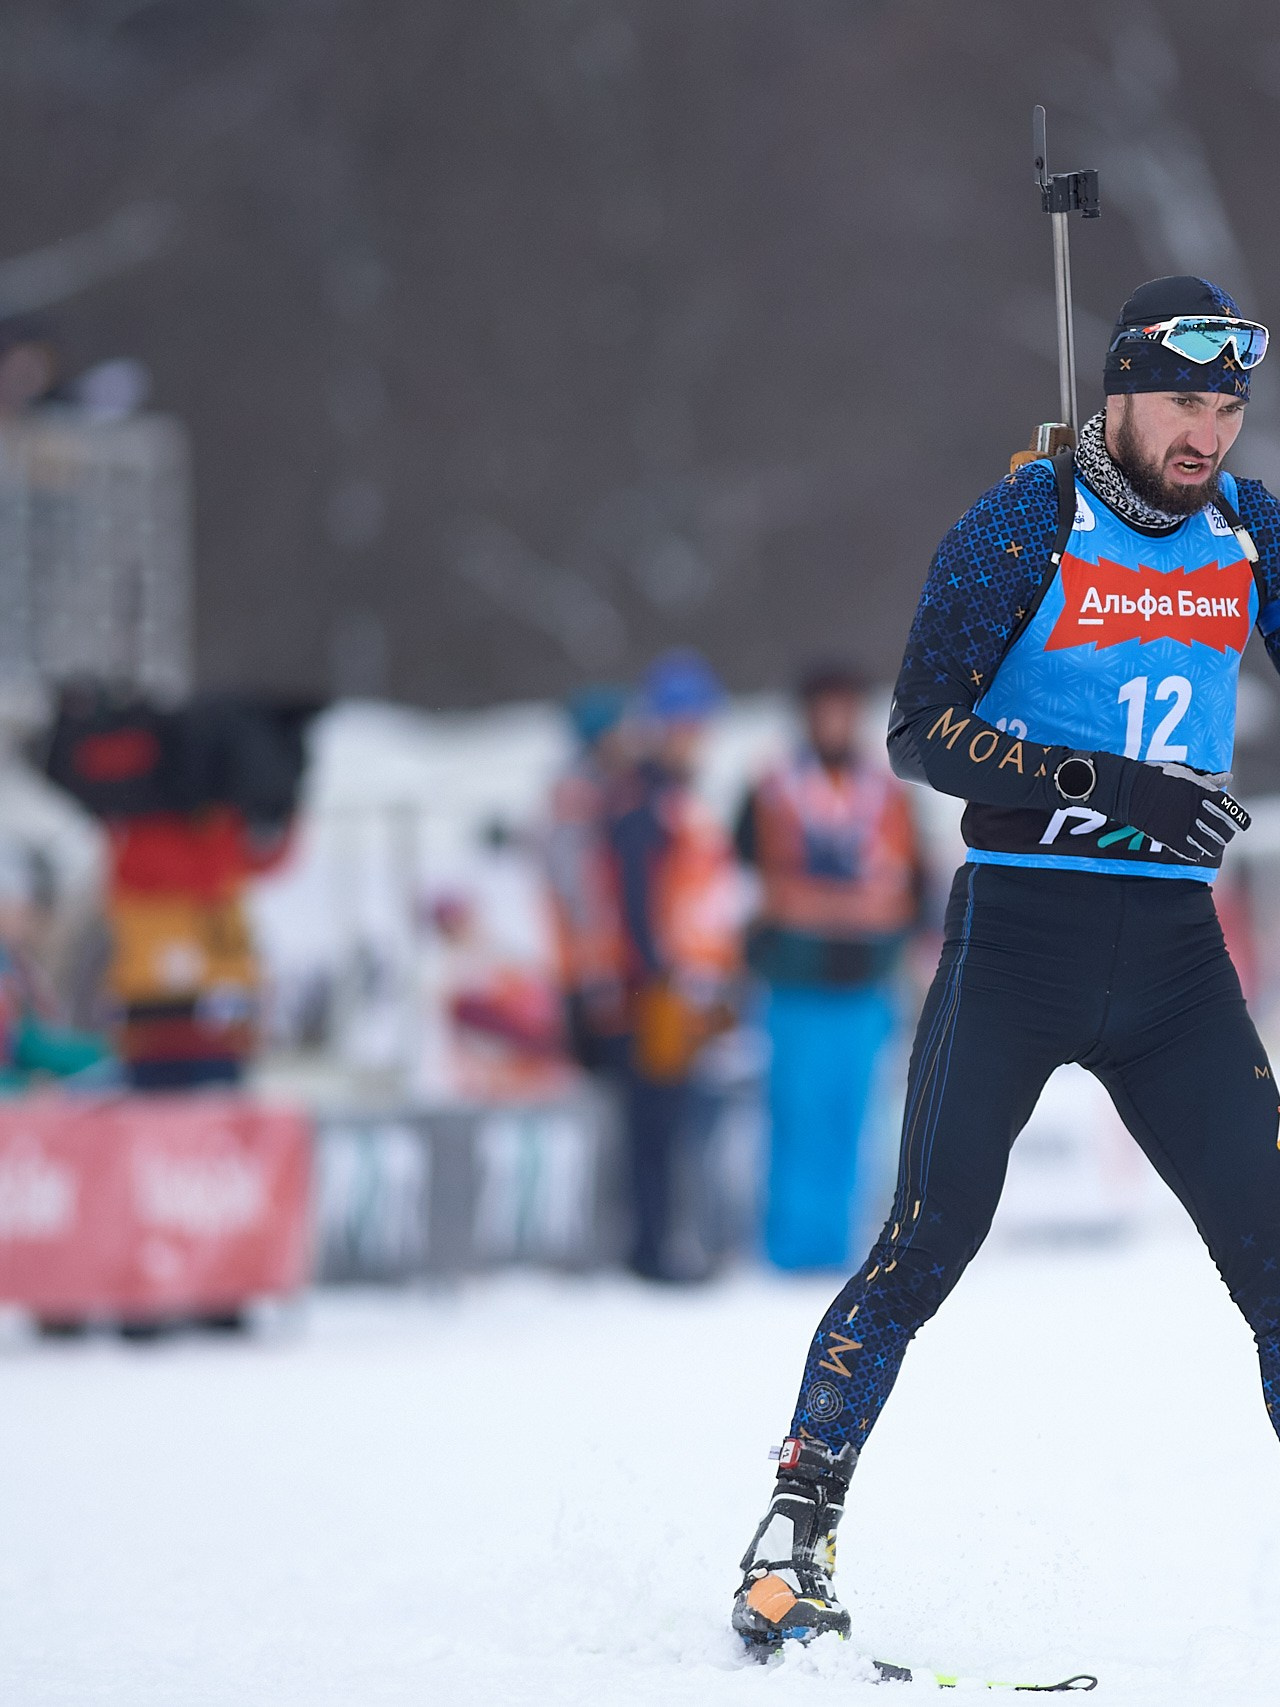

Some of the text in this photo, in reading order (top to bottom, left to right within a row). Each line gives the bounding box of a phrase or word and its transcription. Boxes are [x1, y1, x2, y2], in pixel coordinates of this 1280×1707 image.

[1078, 586, 1241, 624] Альфа Банк
[1118, 675, 1192, 761] 12
